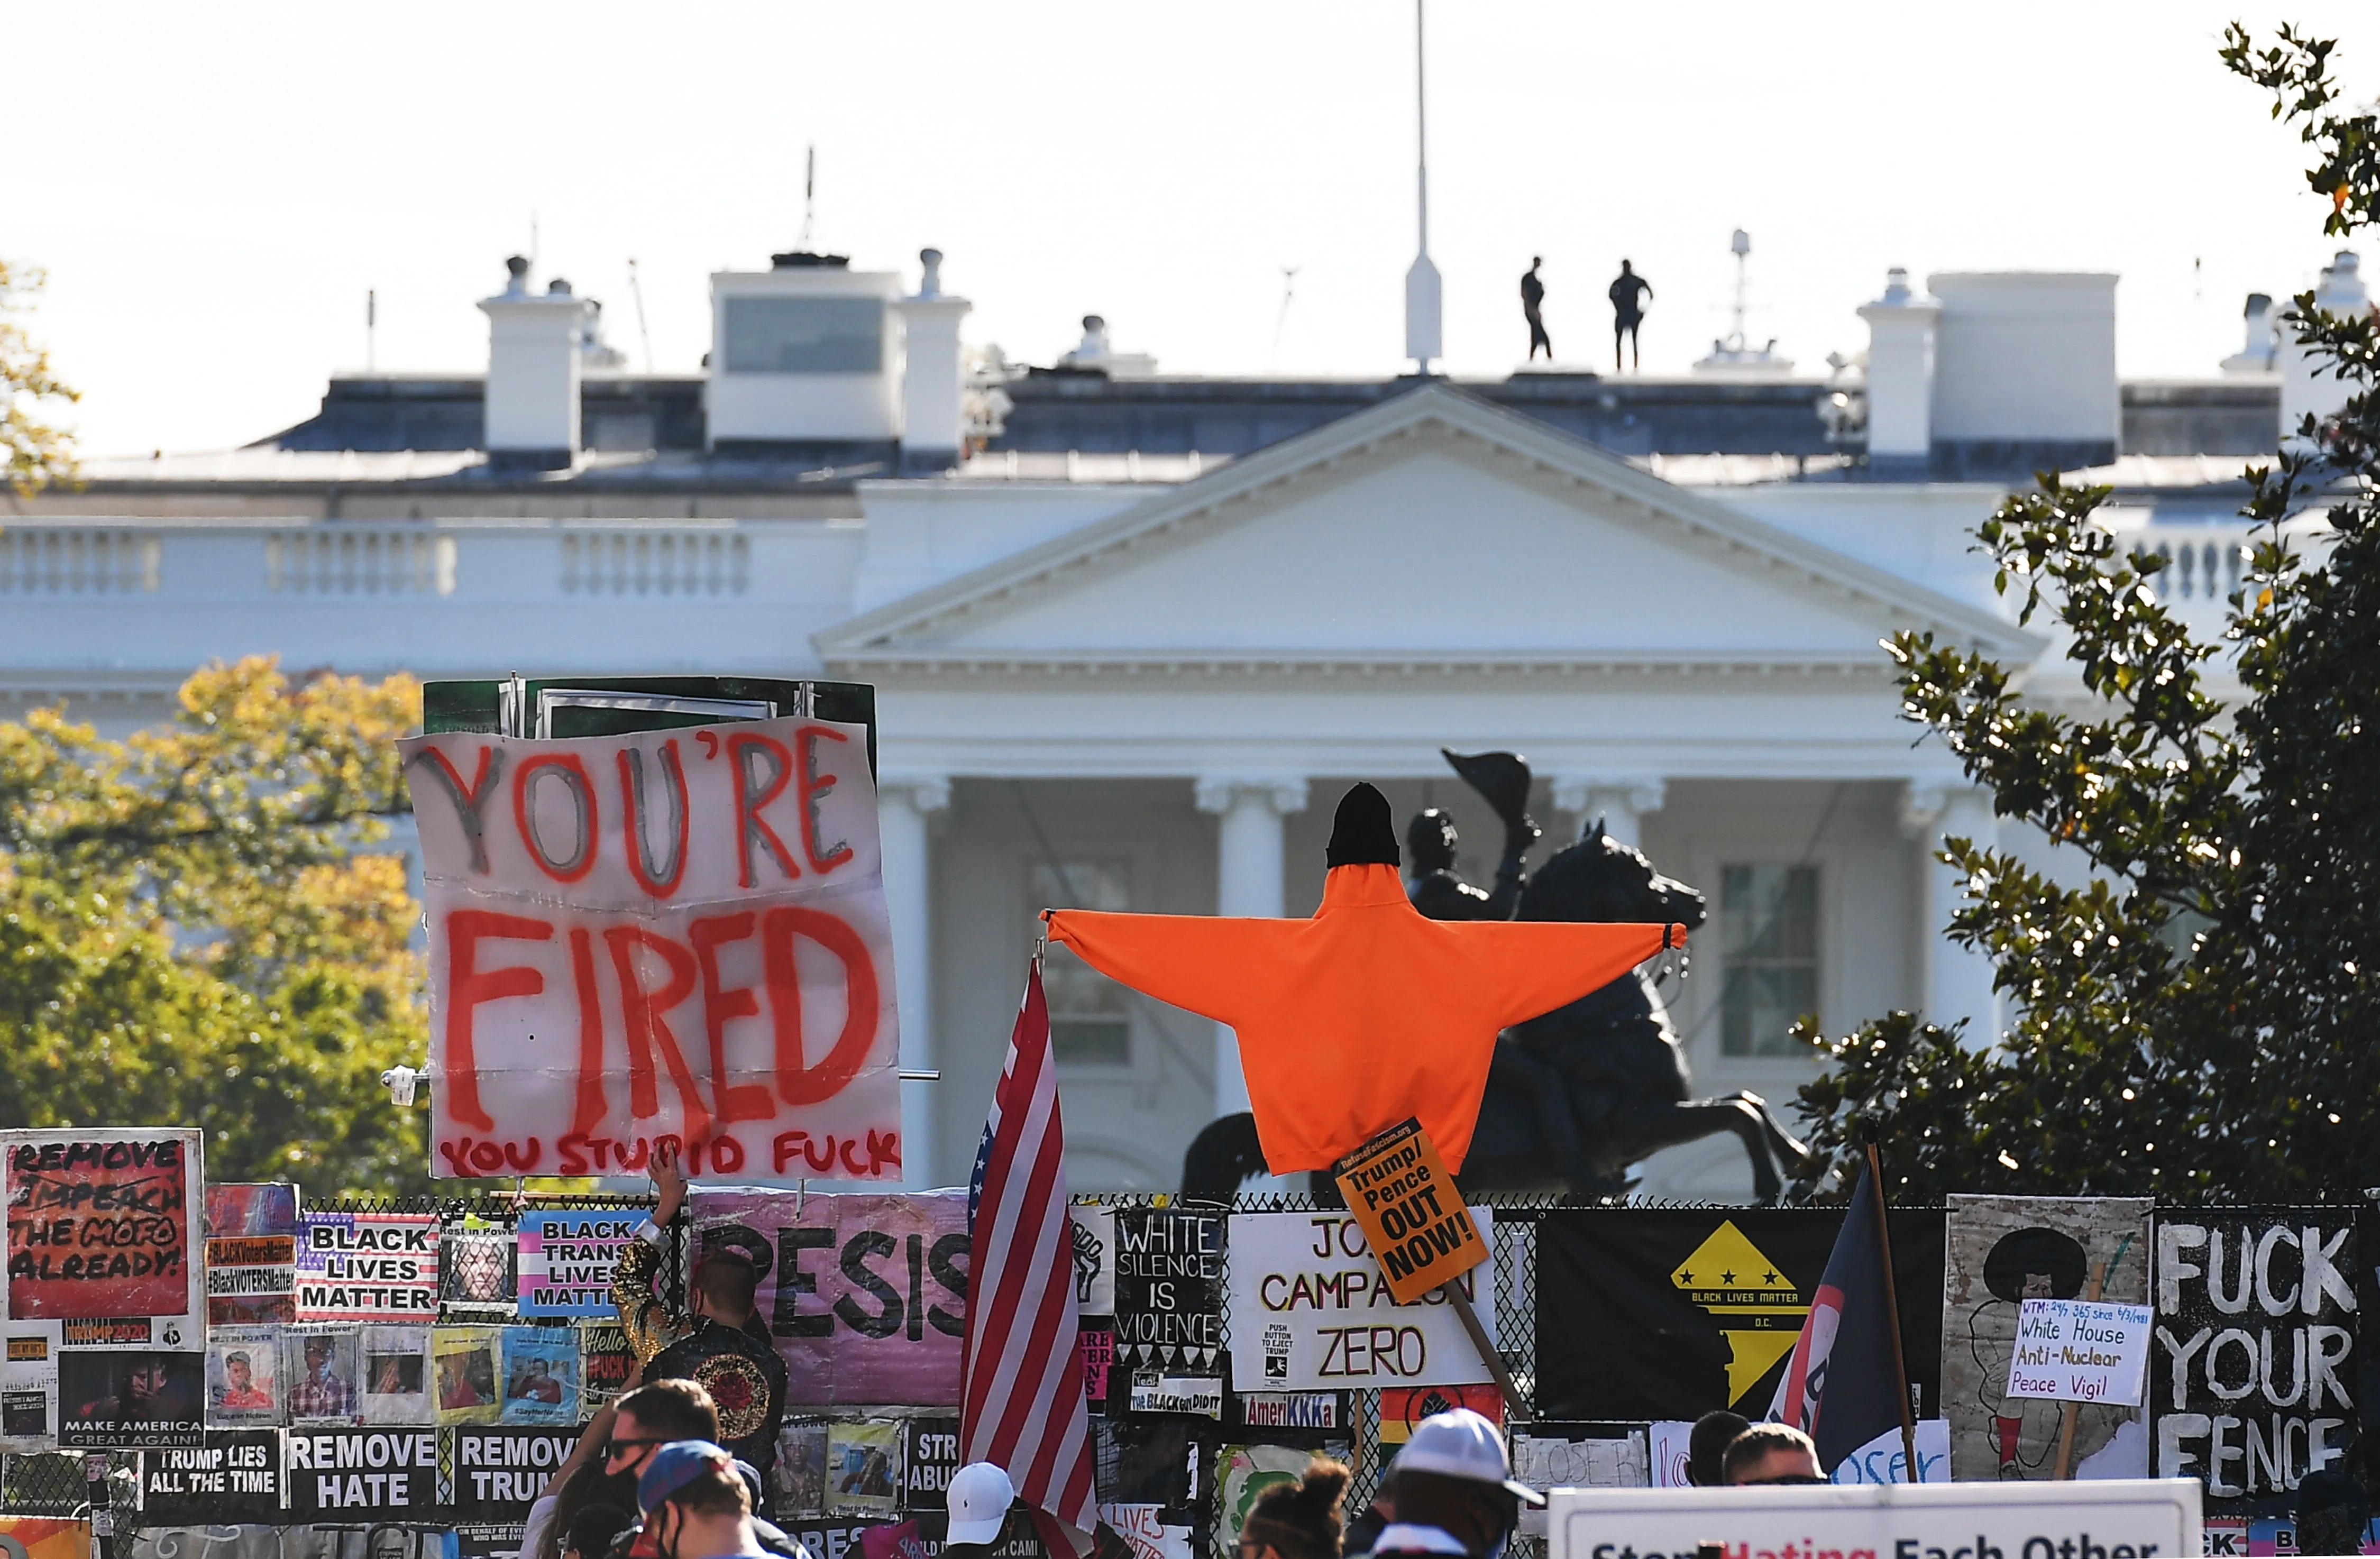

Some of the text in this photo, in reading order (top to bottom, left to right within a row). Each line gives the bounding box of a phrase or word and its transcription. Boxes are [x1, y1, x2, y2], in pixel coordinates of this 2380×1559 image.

[403, 727, 854, 898] YOU'RE
[446, 905, 878, 1141] FIRED
[13, 1140, 180, 1171] REMOVE
[441, 1129, 902, 1176] YOU STUPID FUCK
[1341, 1125, 1411, 1169] RefuseFascism.org
[1347, 1135, 1422, 1193] Trump/
[9, 1175, 182, 1212] IMPEACH
[1363, 1164, 1431, 1212] Pence
[1380, 1184, 1438, 1241] OUT
[8, 1217, 177, 1248] THE MOFO
[311, 1227, 429, 1250] BLACK
[543, 1222, 632, 1239] BLACK
[1120, 1215, 1218, 1253] WHITE
[1312, 1218, 1373, 1259] JO
[1383, 1210, 1473, 1282] NOW!
[9, 1246, 181, 1281] ALREADY!
[327, 1259, 417, 1280] LIVES
[1117, 1253, 1217, 1279] SILENCE
[2158, 1224, 2357, 1316] FUCK
[302, 1287, 431, 1309] MATTER
[534, 1289, 615, 1305] MATT
[1149, 1282, 1175, 1310] IS
[1261, 1270, 1476, 1311] CAMPAN
[1692, 1292, 1798, 1303] BLACK LIVES MATTER
[1755, 1318, 1772, 1327] D.C.
[2051, 1301, 2068, 1318] 24/7
[2073, 1305, 2090, 1318] 365
[2092, 1307, 2113, 1321] since
[2117, 1306, 2148, 1325] 6/3/1981
[587, 1327, 627, 1353] Hello
[1115, 1313, 1218, 1345] VIOLENCE
[1264, 1331, 1292, 1340] BUTTON
[1272, 1340, 1293, 1348] EJECT
[2021, 1318, 2125, 1344] White House
[1317, 1326, 1425, 1376] ZERO
[2016, 1343, 2122, 1369] Anti-Nuclear
[2156, 1325, 2355, 1410] YOUR
[2011, 1371, 2107, 1400] Peace Vigil
[1146, 1393, 1179, 1411] BLACK
[1248, 1397, 1332, 1427] AmeriKKKa
[65, 1420, 203, 1432] MAKE AMERICA
[70, 1435, 198, 1446] GREAT AGAIN!
[161, 1445, 267, 1470] TRUMP LIES
[289, 1434, 436, 1470] REMOVE
[461, 1436, 581, 1466] REMOV
[149, 1471, 275, 1493] ALL THE TIME
[317, 1473, 409, 1508] HATE
[471, 1471, 556, 1501] TRU
[1112, 1505, 1165, 1540] LIVES
[1009, 1539, 1038, 1556] CAM
